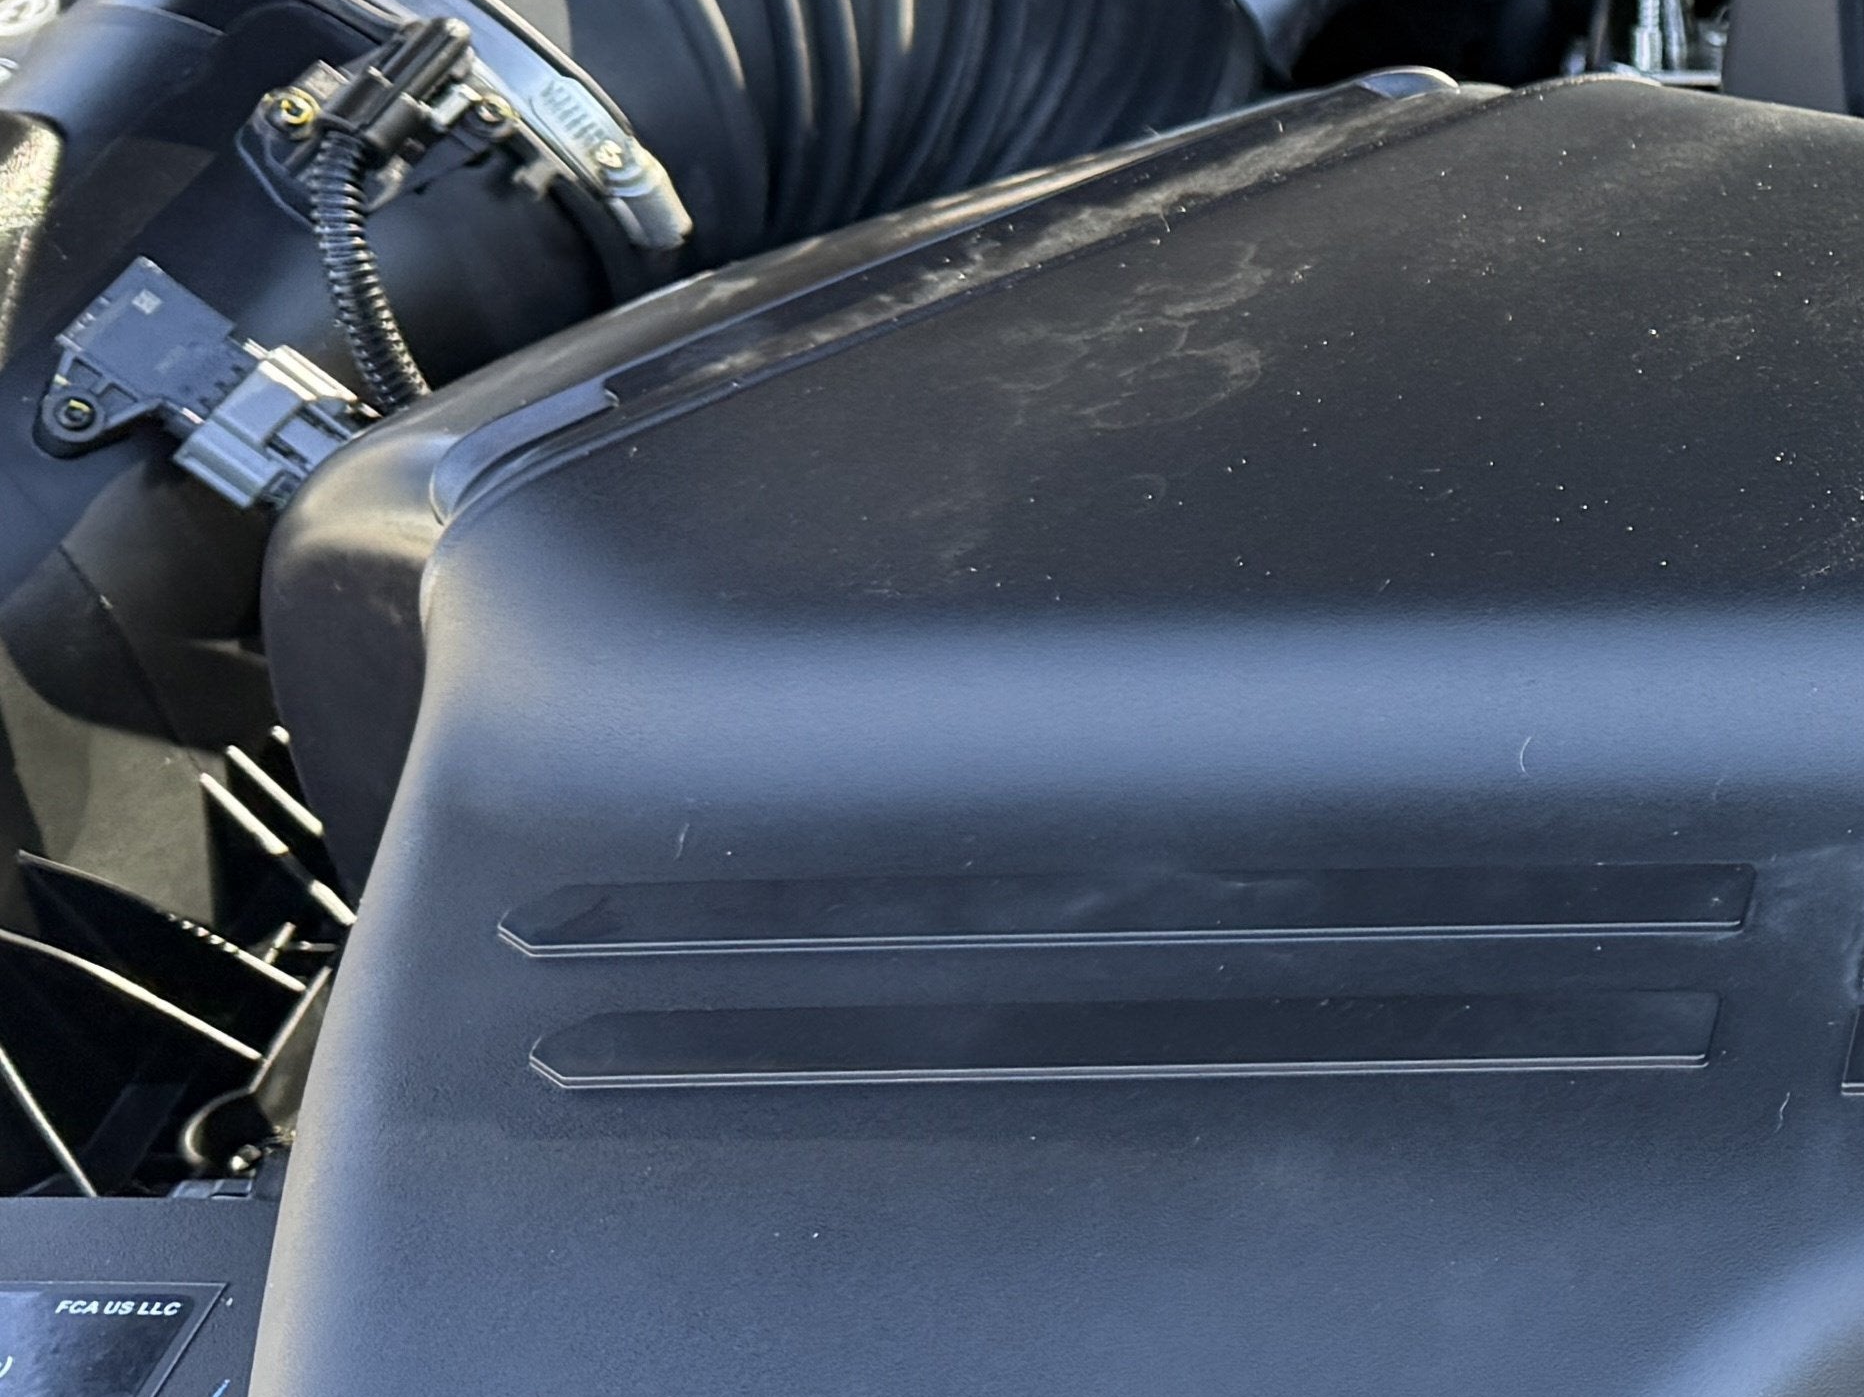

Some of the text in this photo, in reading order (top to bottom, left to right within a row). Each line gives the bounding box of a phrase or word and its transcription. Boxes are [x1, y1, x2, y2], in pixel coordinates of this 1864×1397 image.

[55, 1299, 182, 1316] FCA US LLC
